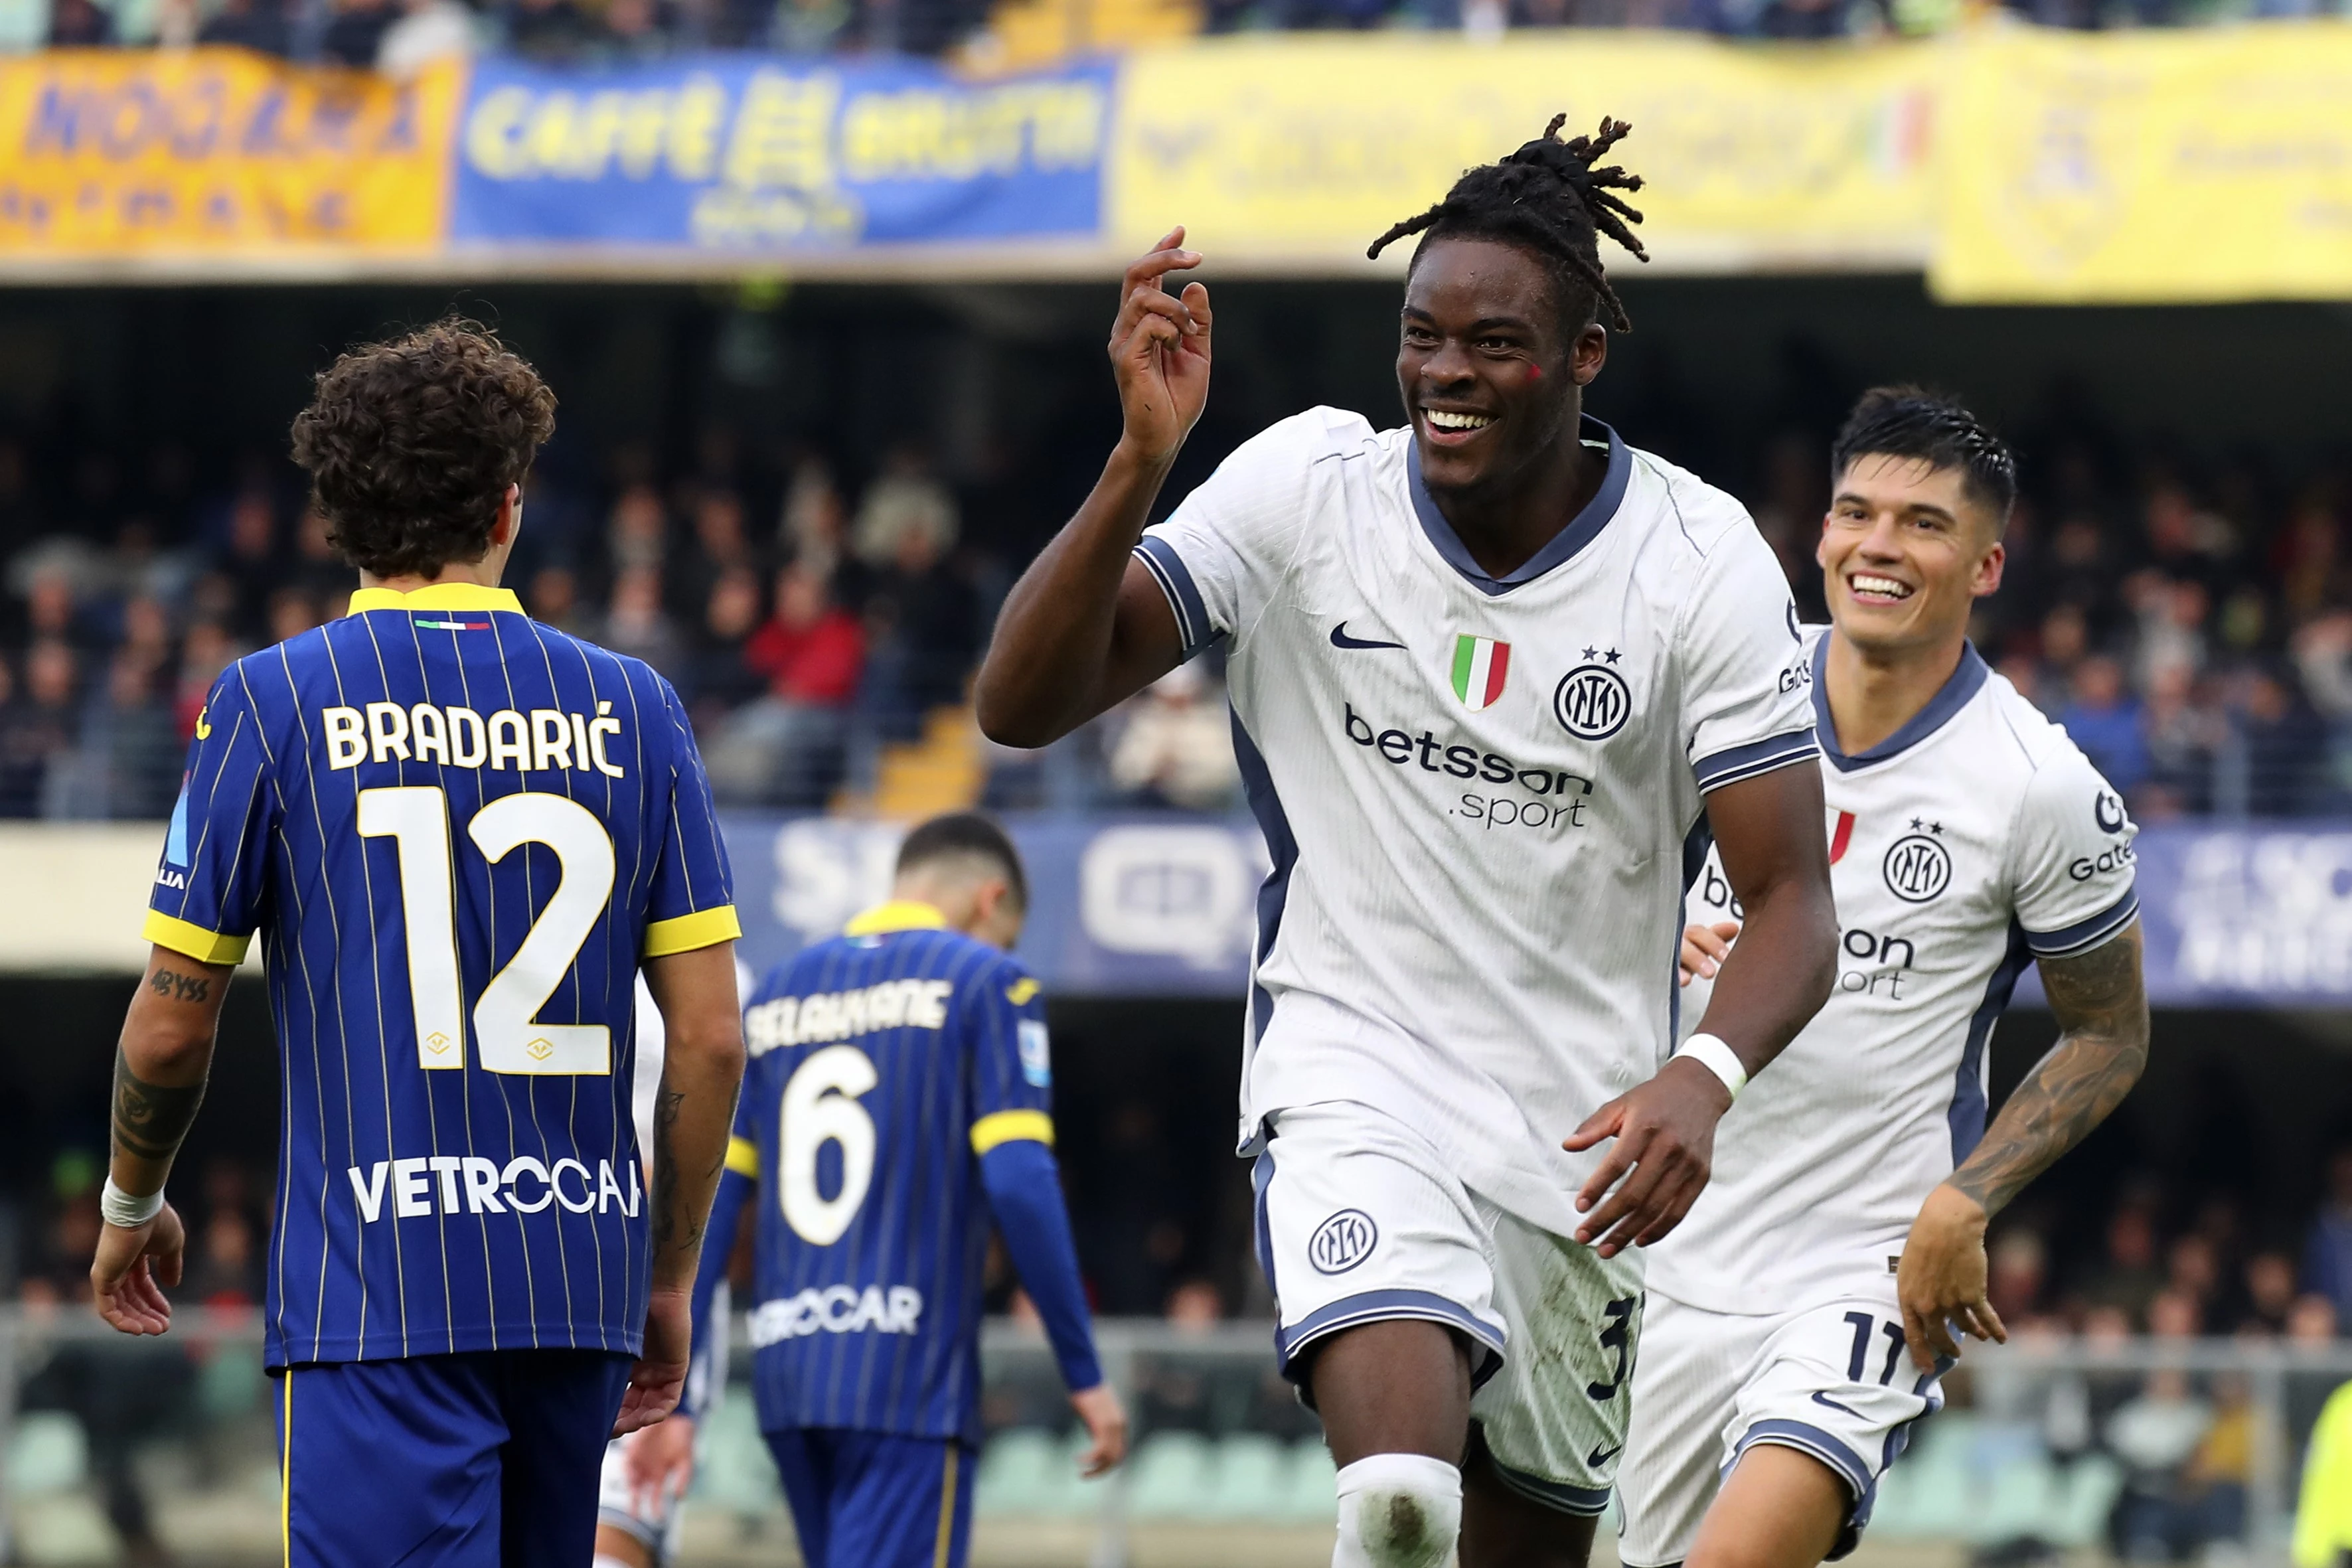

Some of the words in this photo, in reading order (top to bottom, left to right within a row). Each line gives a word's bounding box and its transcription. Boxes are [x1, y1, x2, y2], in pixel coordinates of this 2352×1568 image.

[322, 701, 625, 778] BRADARIĆ
[1345, 702, 1593, 797] betsson
[1449, 794, 1587, 830] .sport
[356, 786, 616, 1076] 12
[779, 1045, 878, 1246] 6
[1587, 1290, 1646, 1401] 3
[1843, 1311, 1907, 1387] 11
